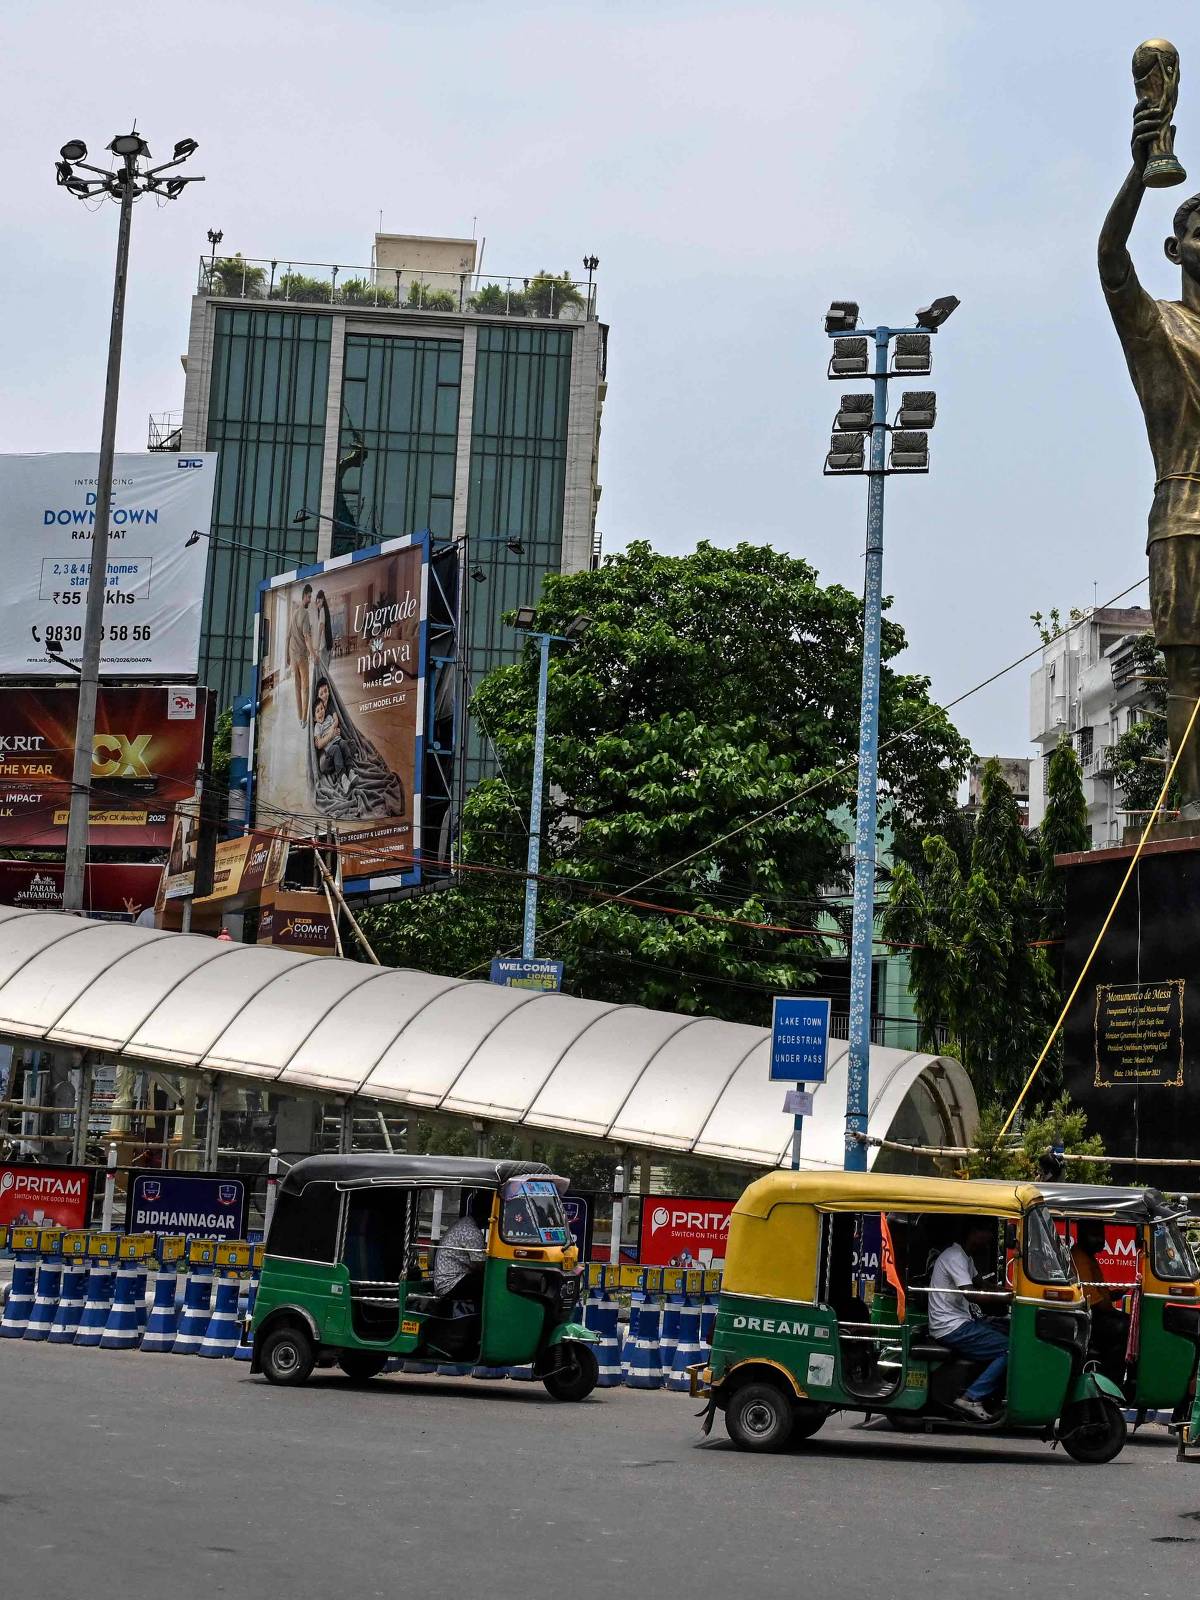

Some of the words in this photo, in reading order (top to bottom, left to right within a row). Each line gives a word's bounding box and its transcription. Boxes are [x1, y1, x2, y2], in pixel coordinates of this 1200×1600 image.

[86, 492, 116, 506] DC
[44, 509, 158, 525] DOWNOWN
[71, 530, 127, 540] RAJHAT
[64, 564, 69, 574] 3
[70, 564, 77, 574] &
[79, 564, 85, 573] 4
[107, 564, 138, 574] homes
[70, 576, 107, 587] star
[109, 576, 119, 586] at
[86, 590, 135, 604] Lkhs
[354, 590, 417, 640] Upgrade
[45, 626, 82, 641] 9830
[109, 625, 128, 641] 58
[132, 625, 151, 641] 56
[384, 627, 392, 638] to
[362, 678, 382, 689] PHASE
[359, 702, 373, 712] VISIT
[372, 697, 392, 708] MODEL
[392, 694, 406, 704] FLAT
[90, 734, 153, 777] CX
[22, 764, 53, 775] YEAR
[5, 793, 43, 803] IMPACT
[148, 814, 166, 822] 2025
[347, 832, 369, 841] SECURITY
[374, 828, 393, 837] LUXURY
[393, 825, 409, 833] FINISH
[30, 884, 56, 892] PARAM
[17, 891, 64, 900] SAIYAMOTSA
[294, 923, 330, 934] COMFY
[294, 932, 327, 940] CASUALS
[499, 963, 558, 973] WELCOME
[780, 1017, 799, 1026] LAKE
[803, 1017, 822, 1027] TOWN
[777, 1035, 822, 1045] PEDESTRIAN
[775, 1054, 800, 1063] UNDER
[803, 1054, 822, 1064] PASS
[15, 1175, 81, 1195] PRITAM
[65, 1196, 80, 1204] TIMES
[136, 1210, 235, 1229] BIDHANNAGAR
[672, 1211, 731, 1231] PRITA
[671, 1230, 695, 1239] SWITCH
[695, 1231, 705, 1239] ON
[706, 1232, 718, 1240] THE
[1096, 1257, 1115, 1265] OOD
[1116, 1258, 1136, 1267] TIMES
[733, 1316, 809, 1337] DREAM
